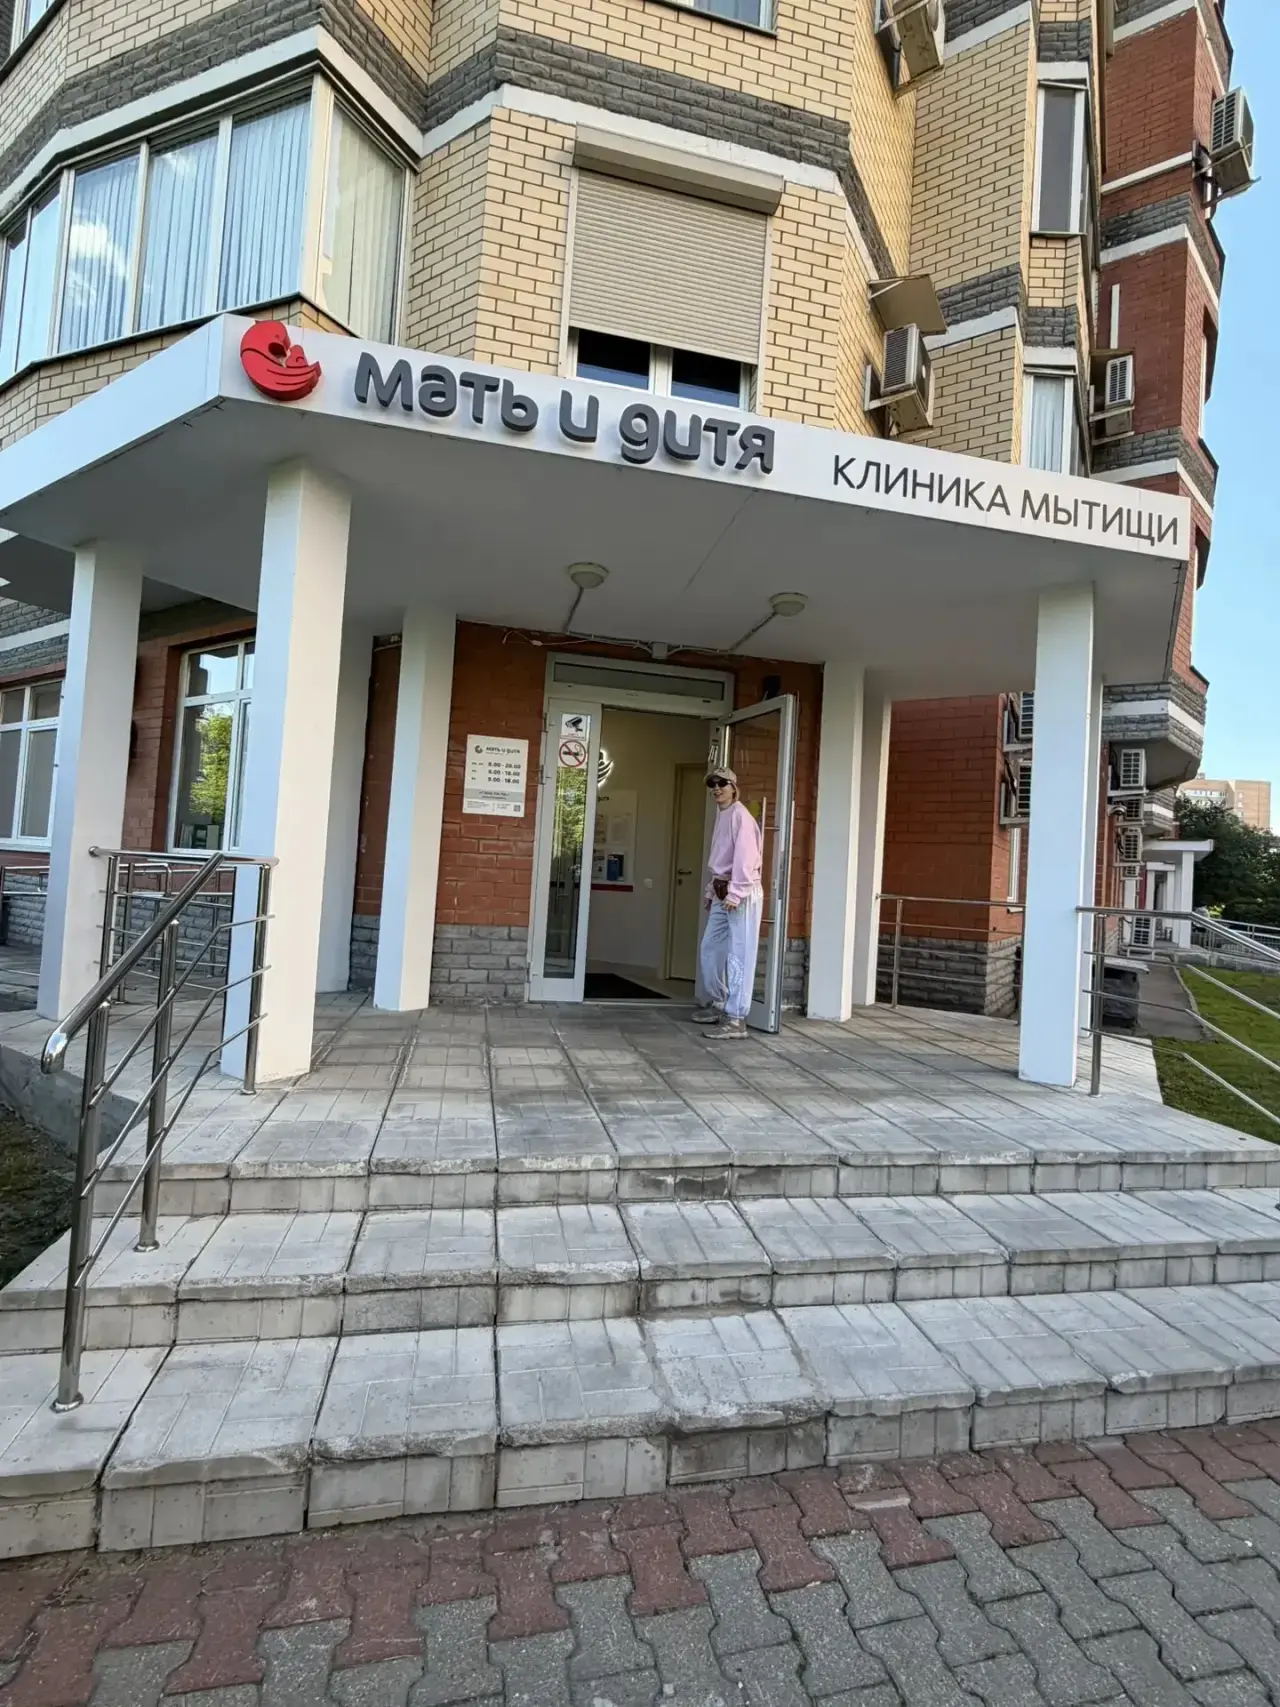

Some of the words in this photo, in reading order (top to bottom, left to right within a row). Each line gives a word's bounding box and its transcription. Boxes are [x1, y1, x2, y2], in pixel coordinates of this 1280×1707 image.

[559, 389, 599, 443] и
[833, 454, 1011, 516] КЛИНИКА
[1020, 489, 1179, 547] МЫТИЩИ
